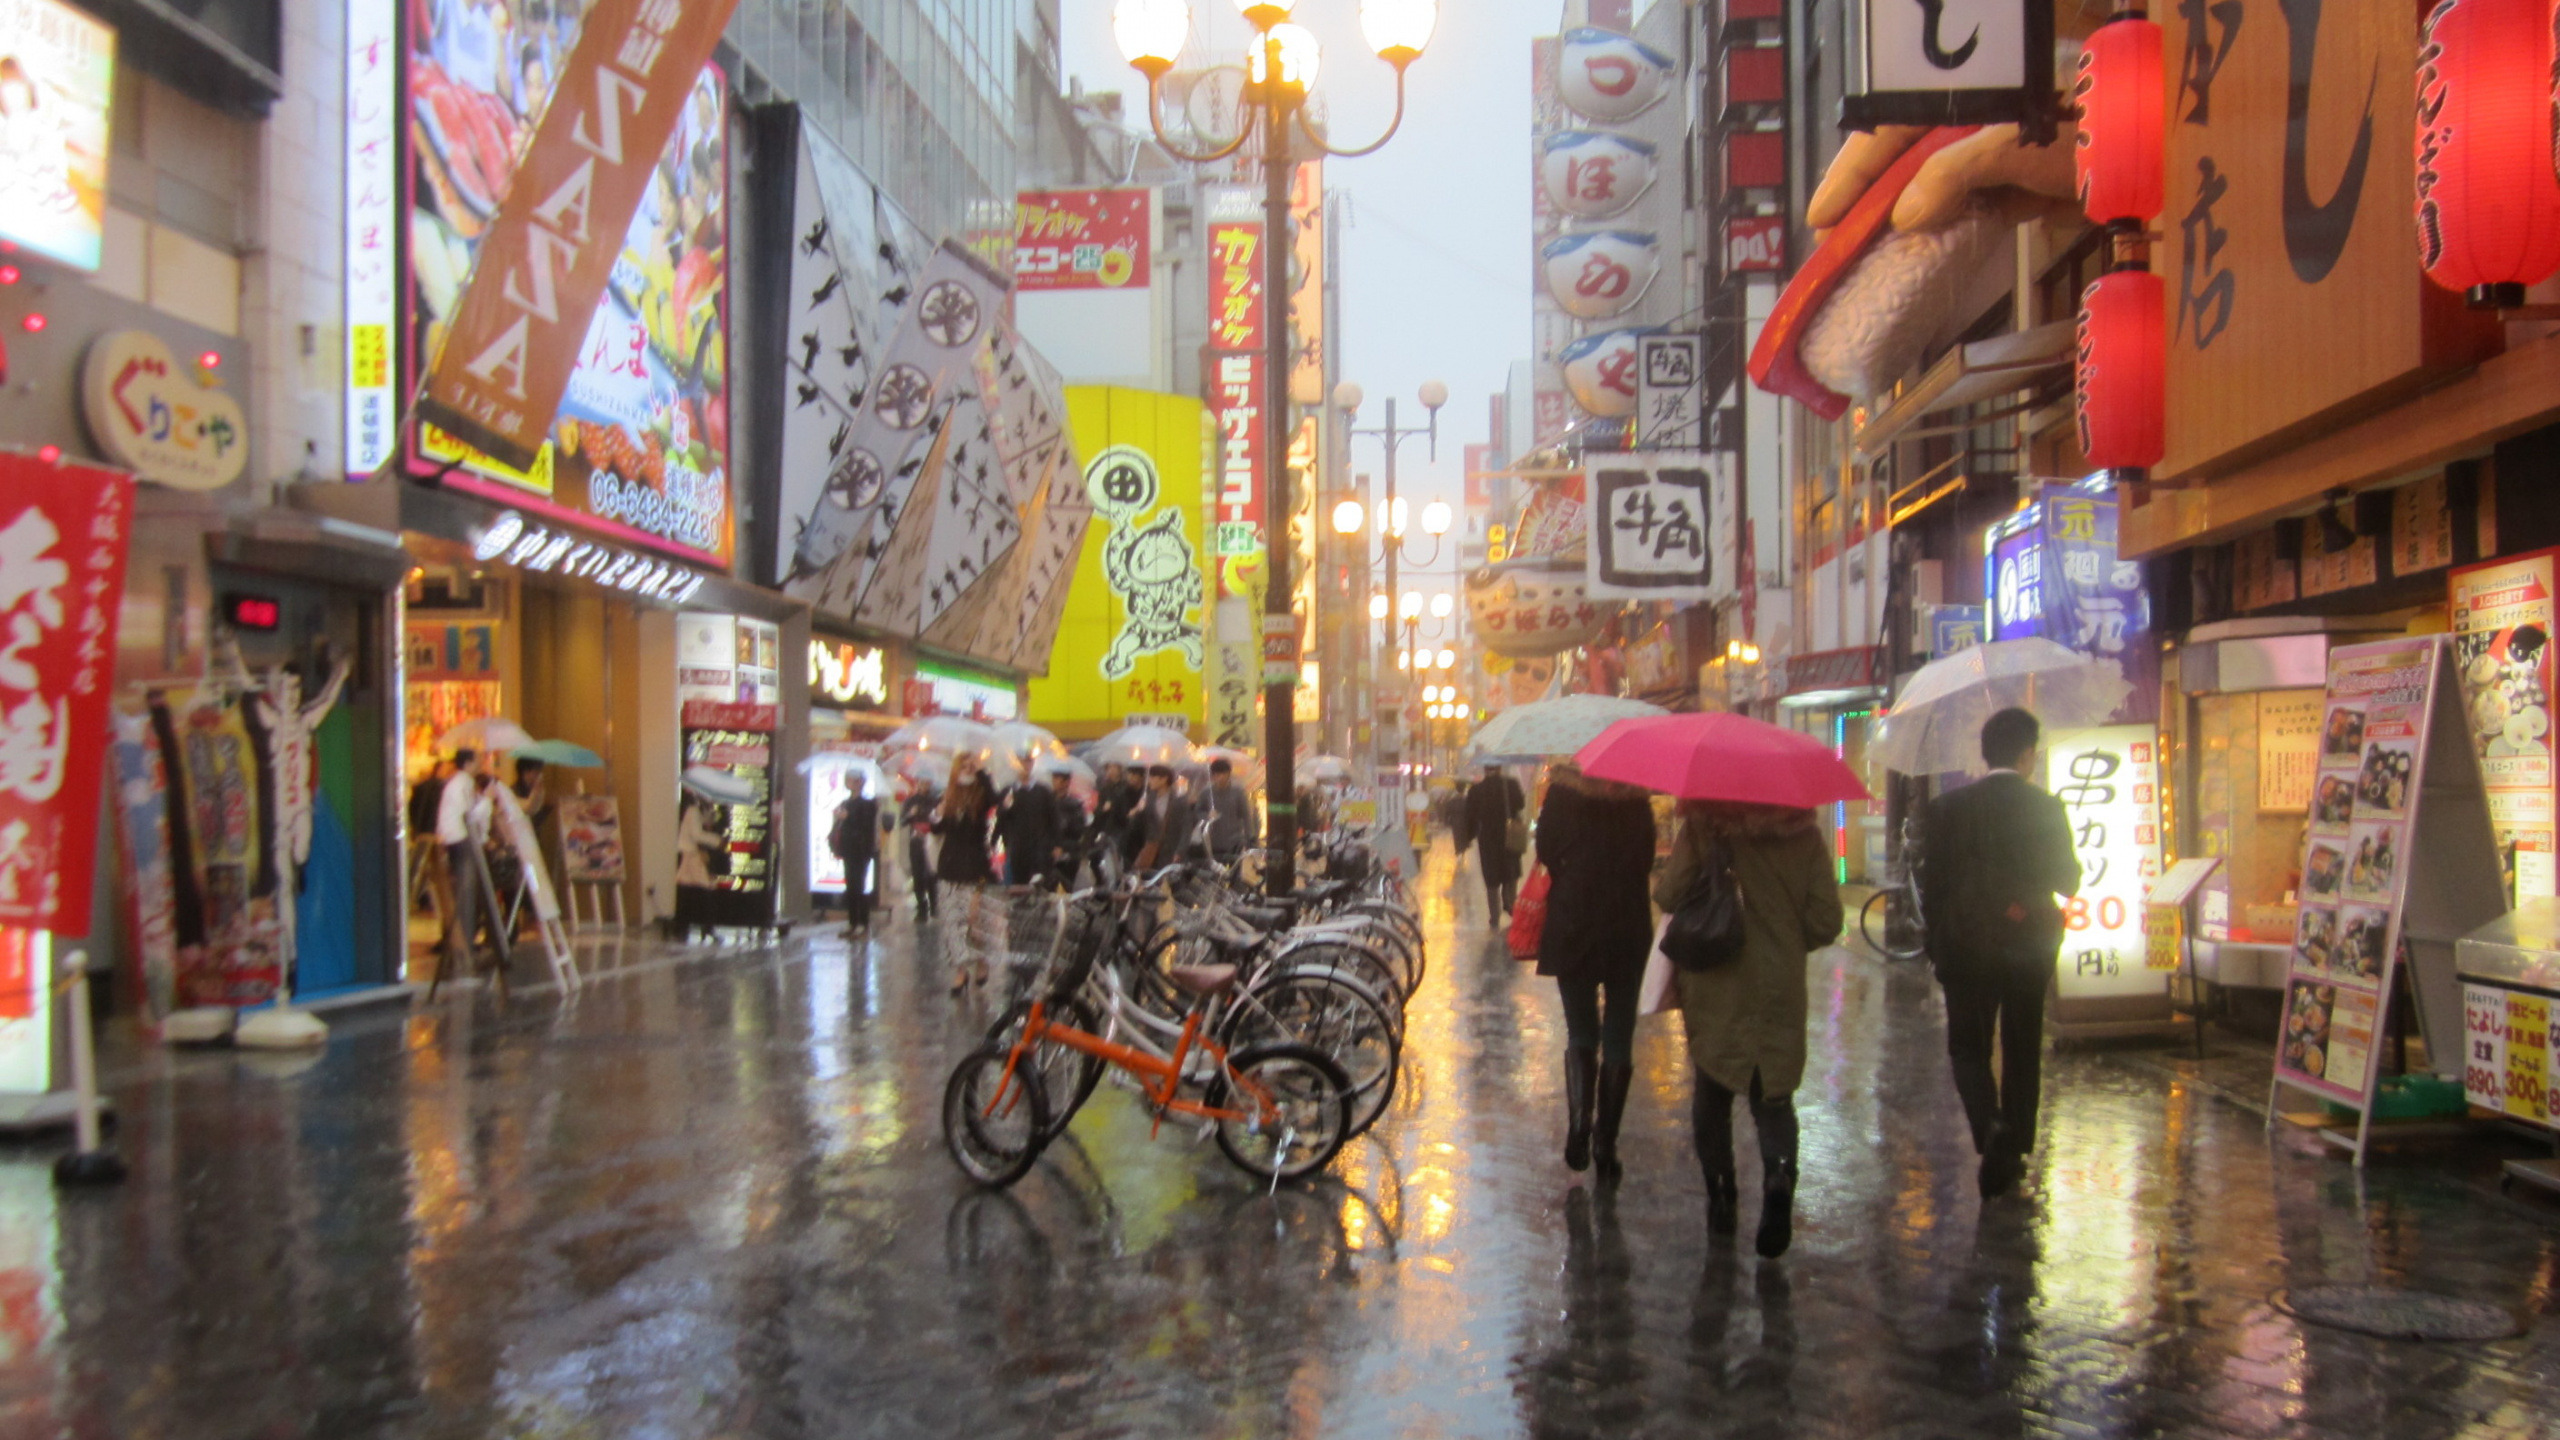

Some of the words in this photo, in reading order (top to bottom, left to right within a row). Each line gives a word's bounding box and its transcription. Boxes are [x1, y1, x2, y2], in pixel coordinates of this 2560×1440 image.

[1216, 226, 1258, 346] カラオケ
[1219, 356, 1259, 522] ビッグエコー
[1614, 489, 1703, 561] 牛角
